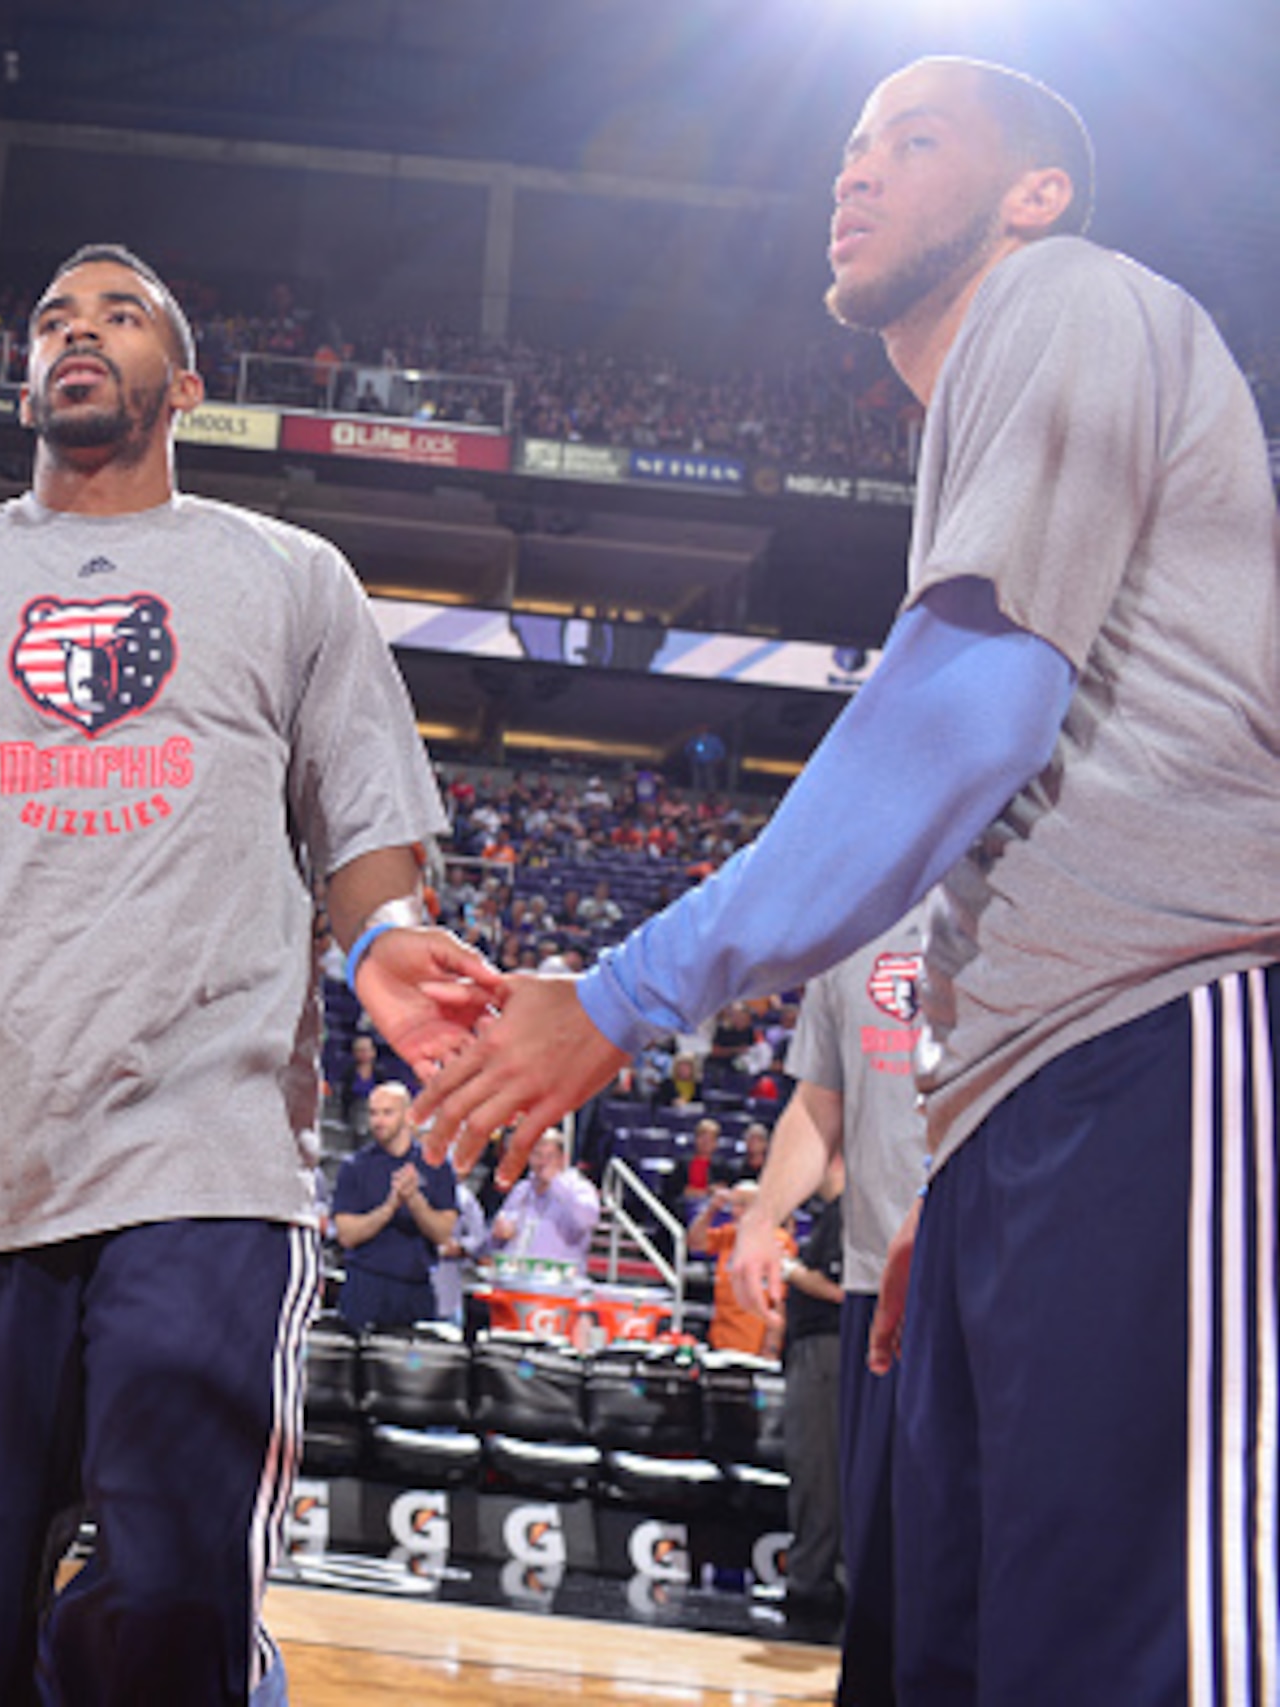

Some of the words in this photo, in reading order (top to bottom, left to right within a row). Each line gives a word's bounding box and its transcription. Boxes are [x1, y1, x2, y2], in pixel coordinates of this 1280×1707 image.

[177, 411, 248, 437] CHOOLS
[388, 1489, 450, 1553] G
[503, 1503, 567, 1564] G
